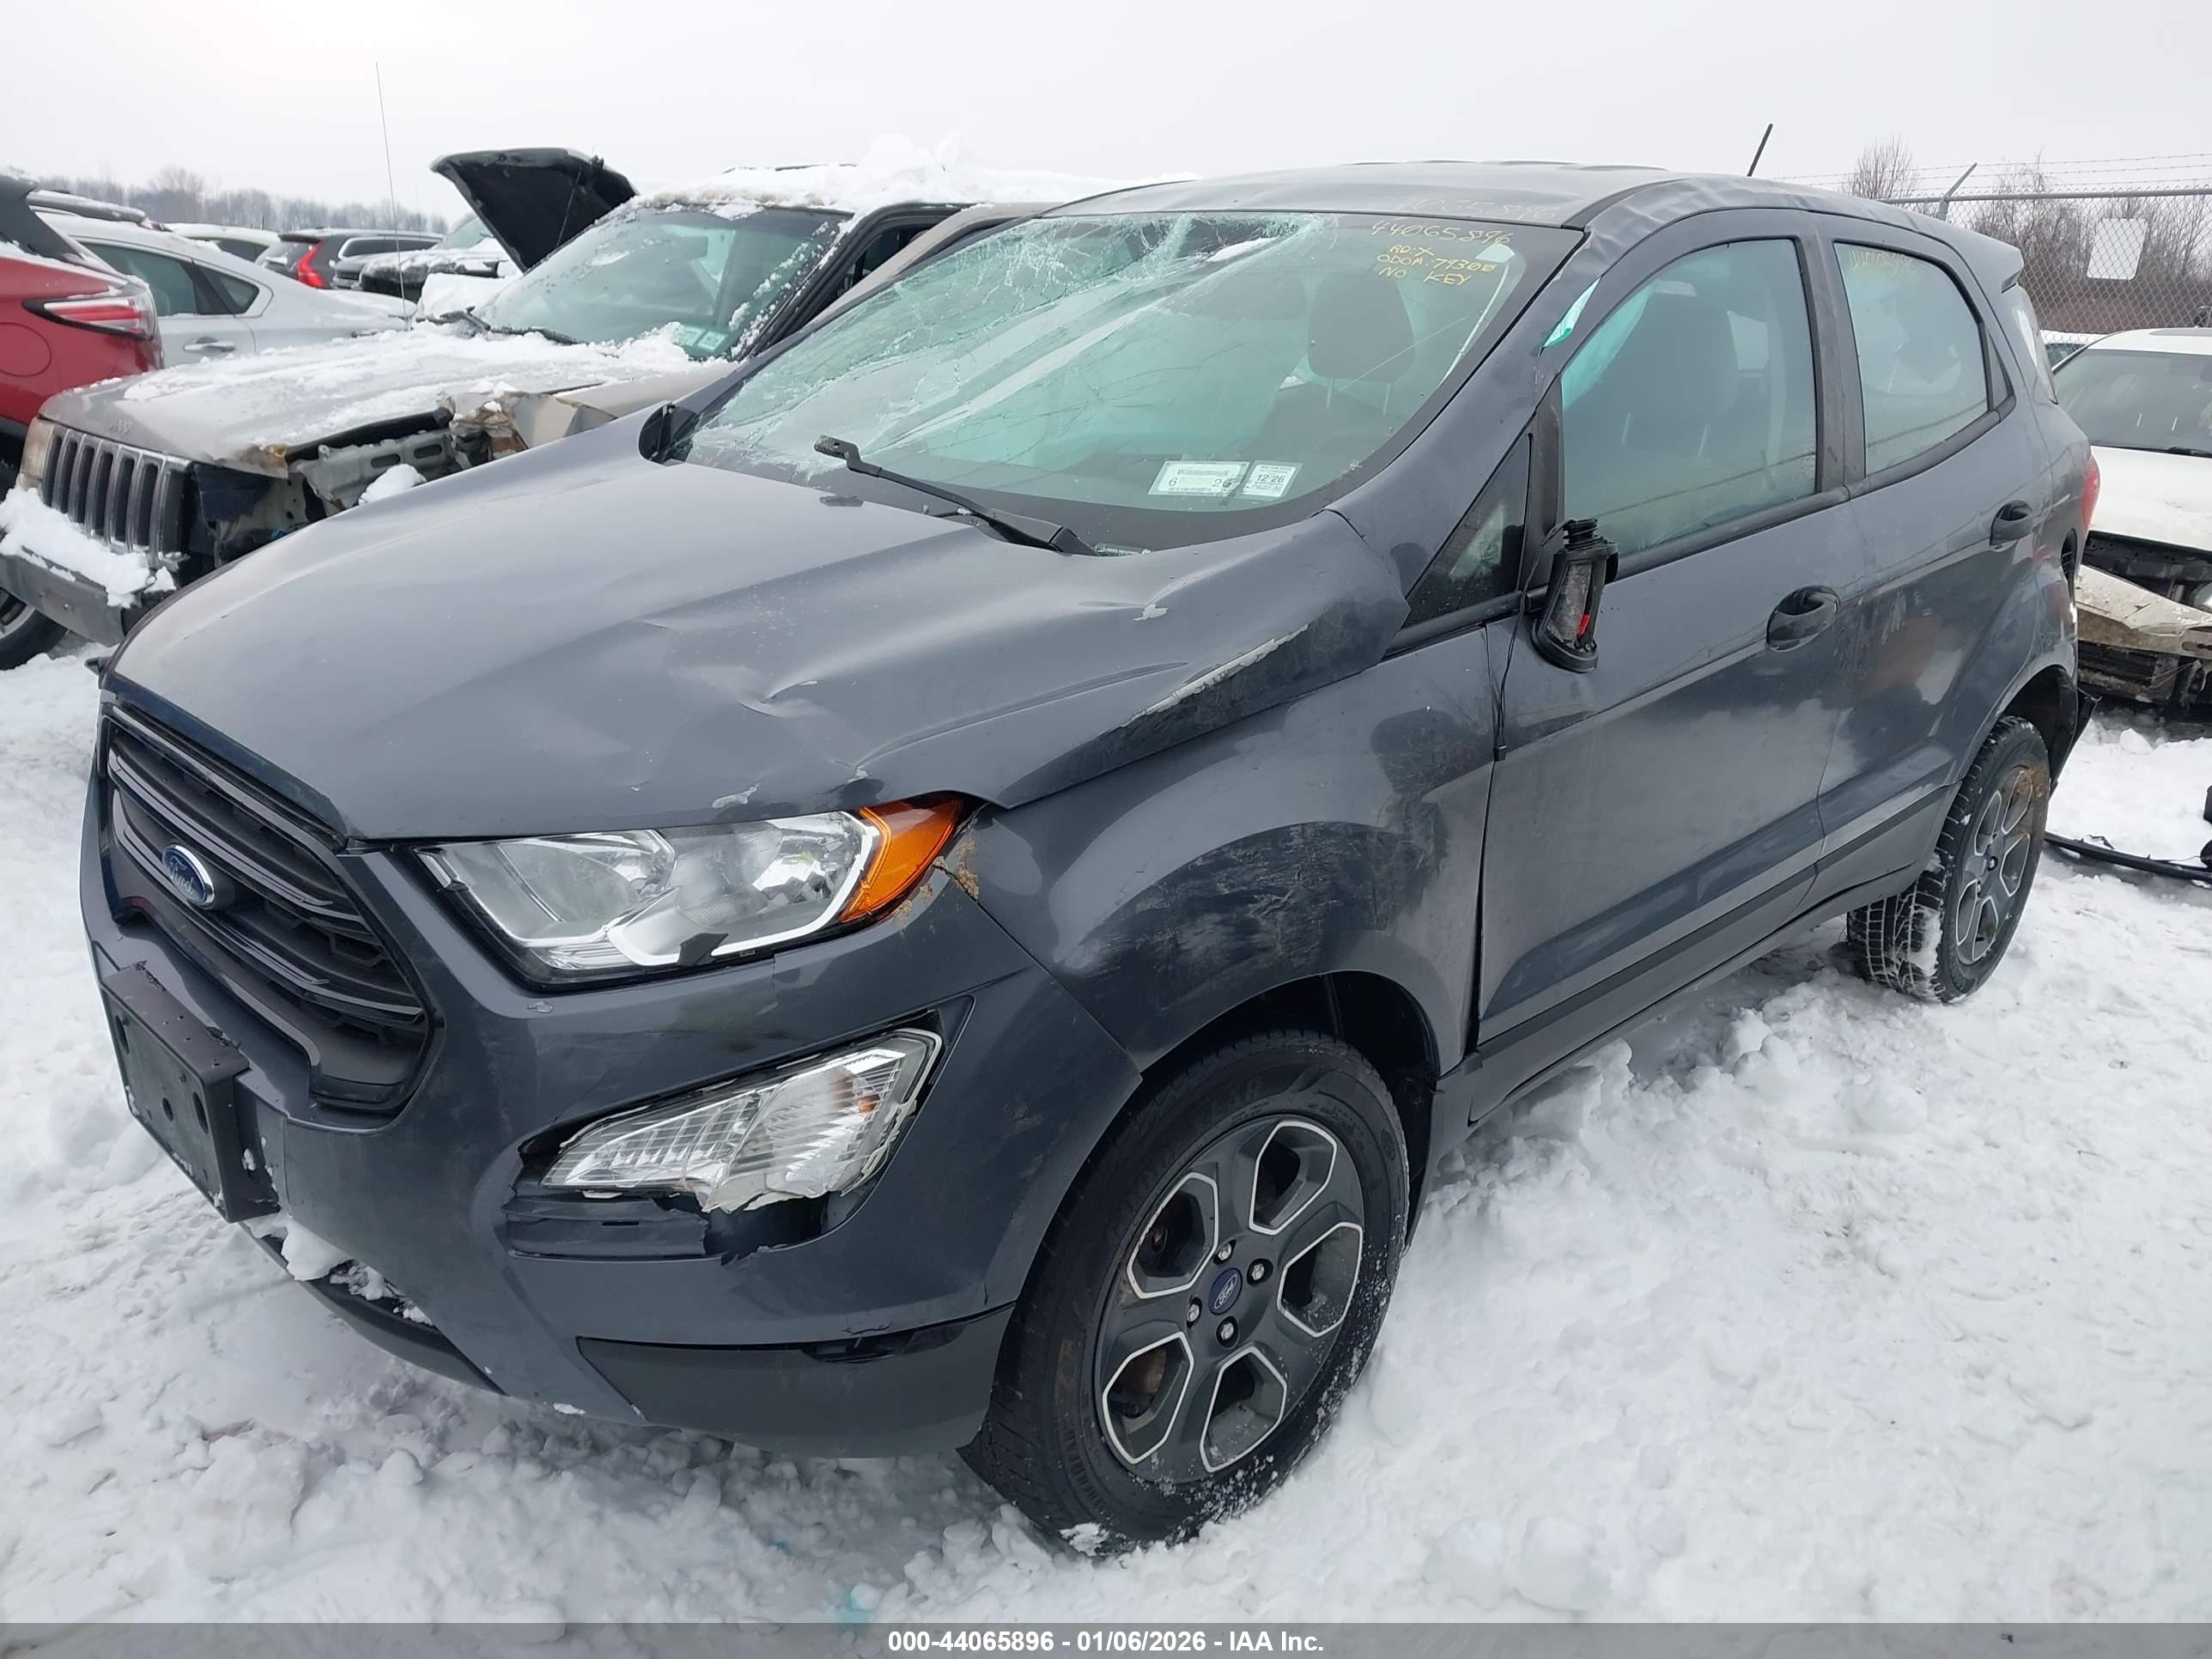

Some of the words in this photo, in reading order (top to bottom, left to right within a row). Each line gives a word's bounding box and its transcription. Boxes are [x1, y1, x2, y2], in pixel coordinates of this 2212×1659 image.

[1371, 219, 1514, 244] 44065896
[1378, 267, 1407, 278] NO
[1423, 270, 1472, 286] KEY
[1168, 477, 1178, 487] 6
[168, 854, 194, 896] Ford
